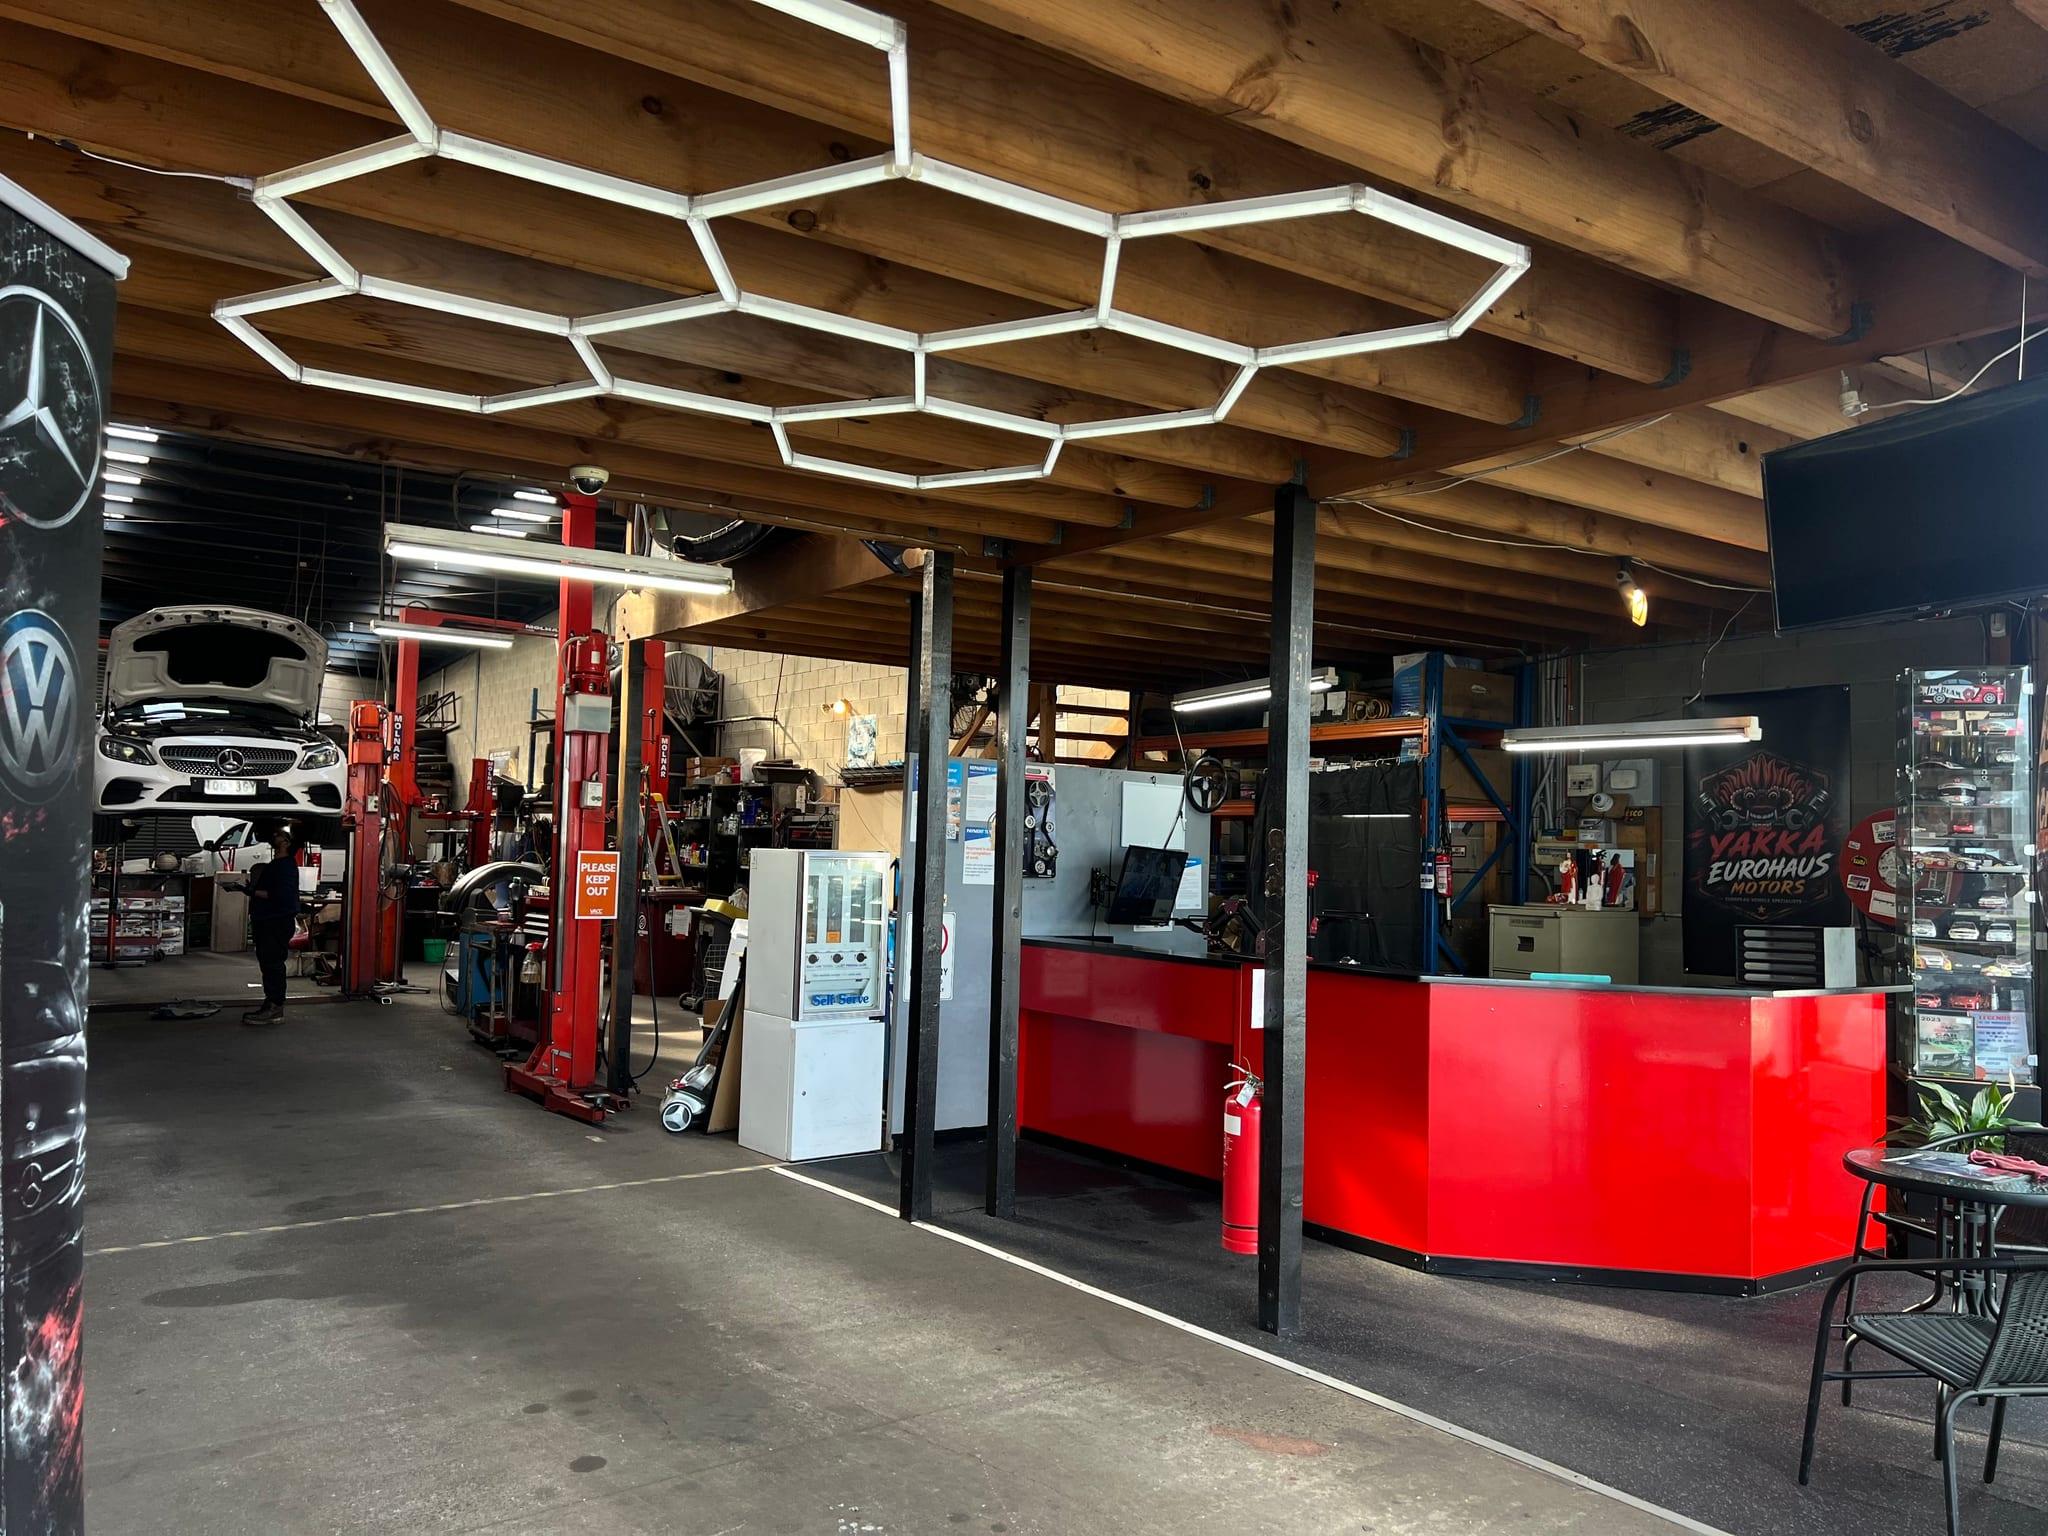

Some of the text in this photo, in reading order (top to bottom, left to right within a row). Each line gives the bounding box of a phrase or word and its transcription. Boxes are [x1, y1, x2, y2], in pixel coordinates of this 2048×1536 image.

[393, 714, 403, 761] MOLNAR
[661, 737, 669, 778] MOLNAR
[1710, 824, 1827, 861] YAKKA
[581, 863, 616, 872] PLEASE
[586, 875, 610, 884] KEEP
[1707, 852, 1835, 885] EUROHAUS
[586, 887, 609, 896] OUT
[1730, 879, 1806, 895] MOTORS
